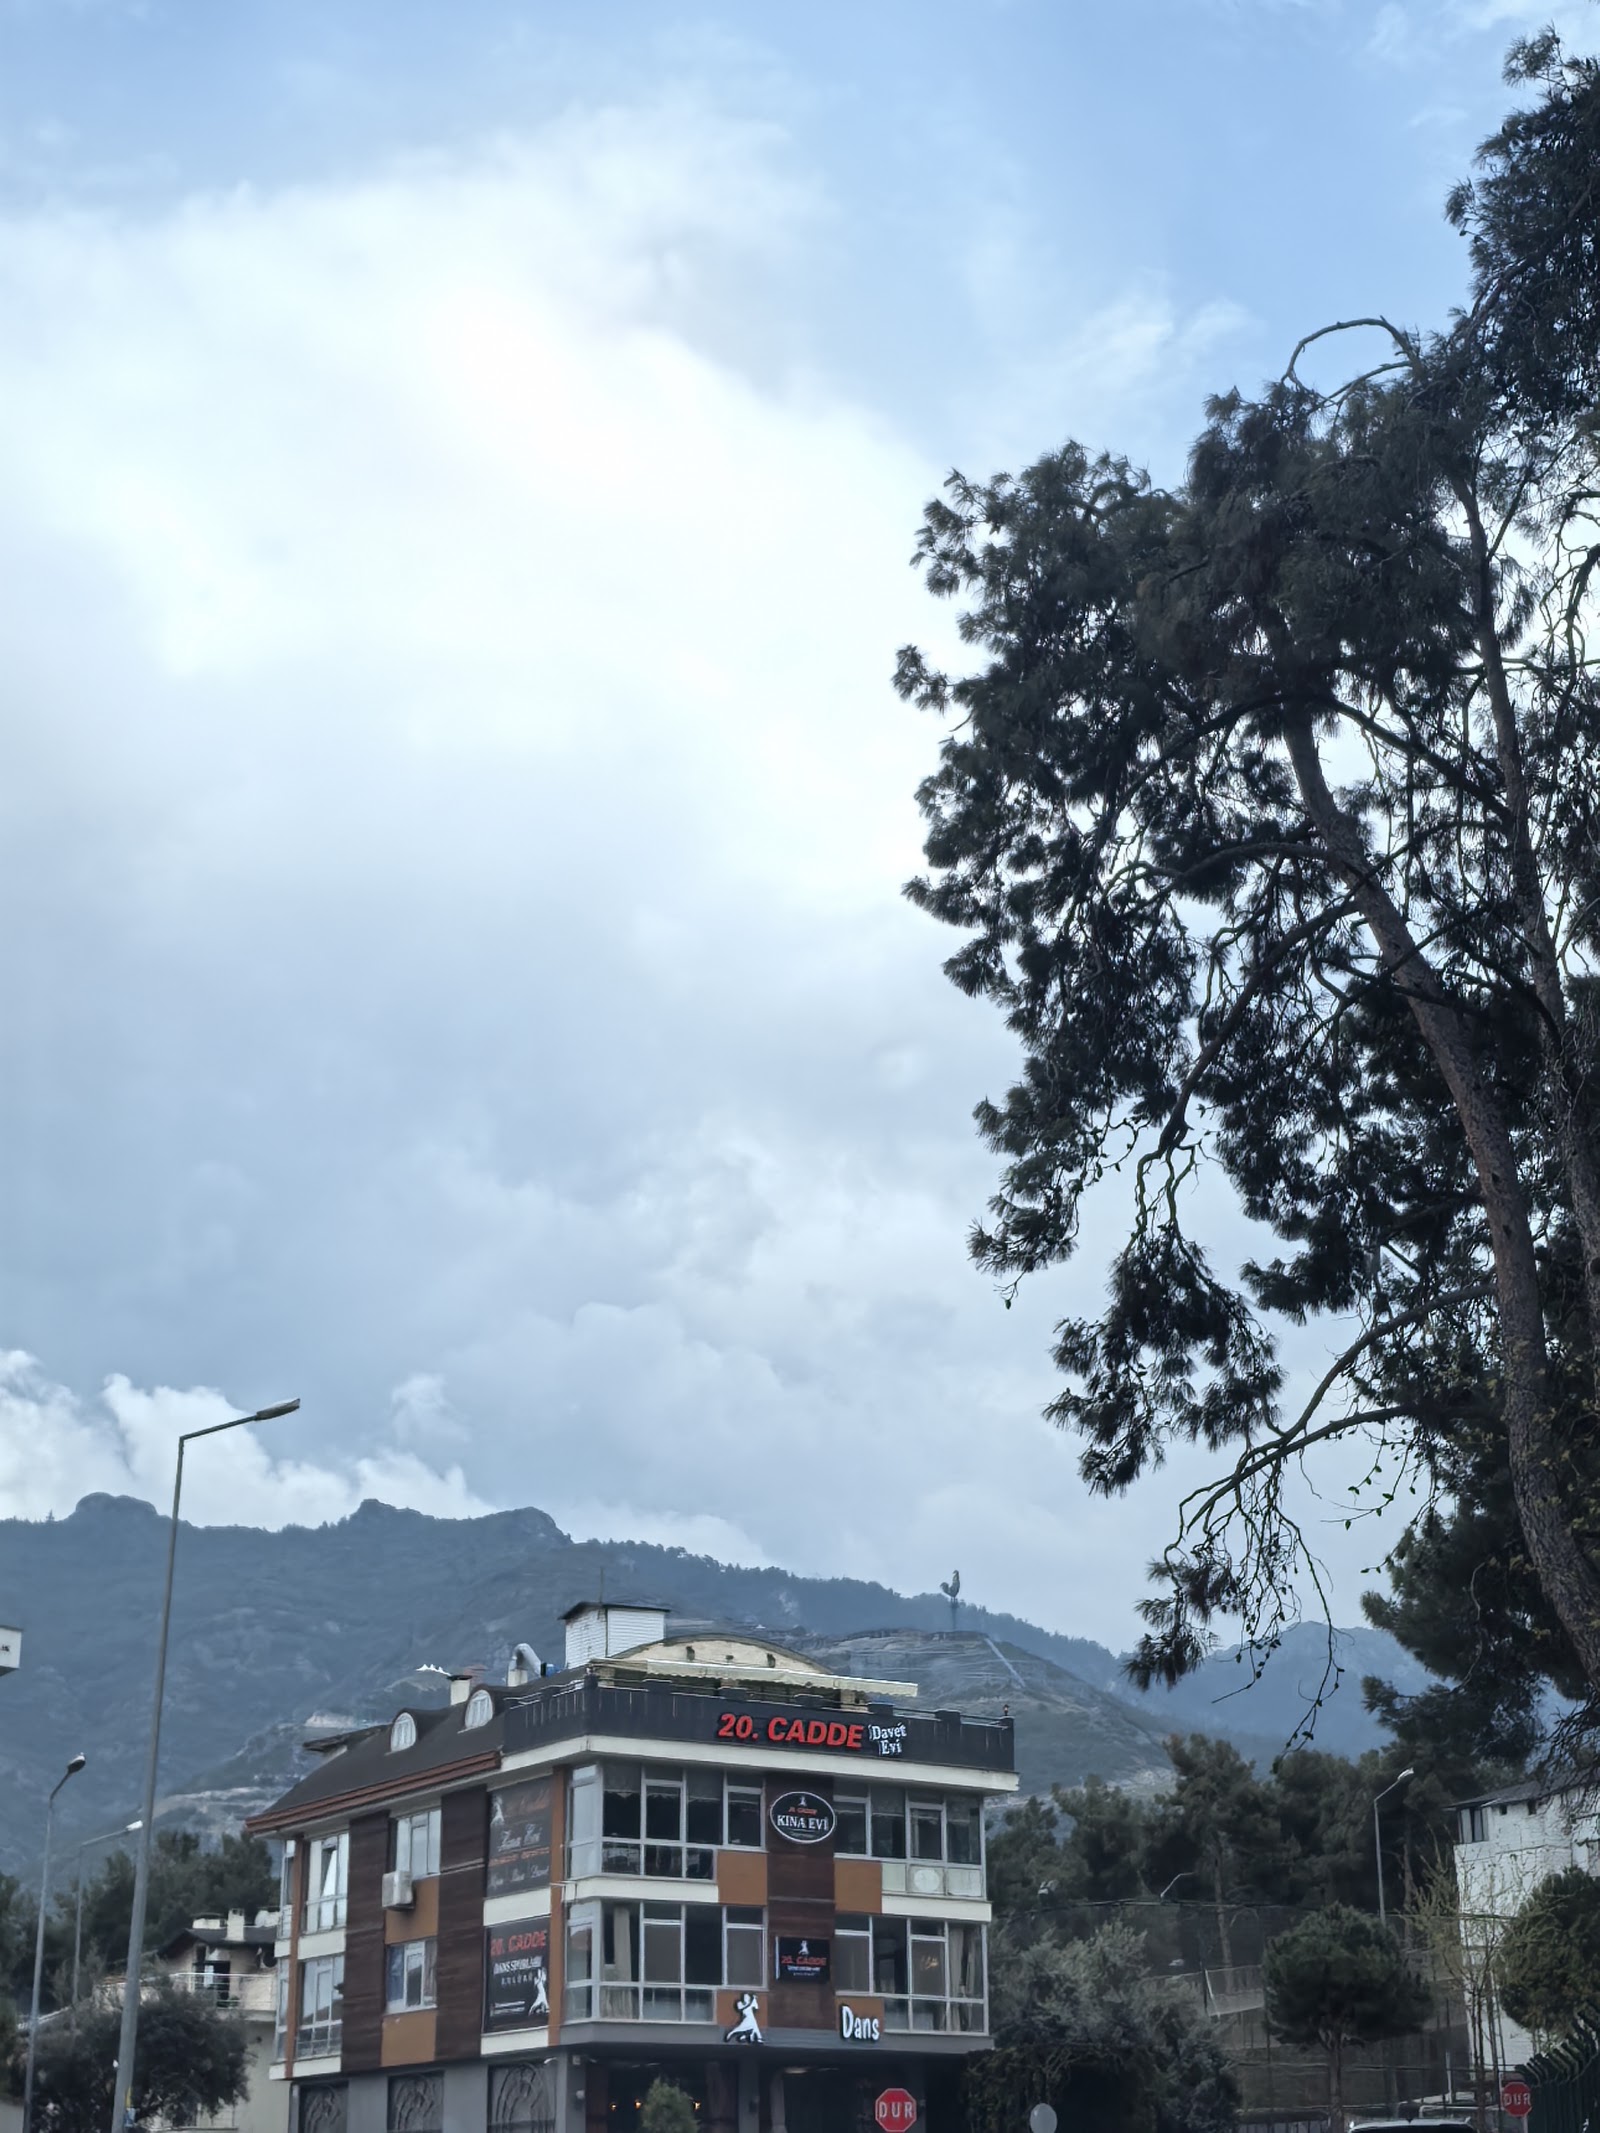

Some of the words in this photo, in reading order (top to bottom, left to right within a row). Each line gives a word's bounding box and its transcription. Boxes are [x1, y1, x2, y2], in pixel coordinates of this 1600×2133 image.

[718, 1713, 759, 1739] 20.
[768, 1716, 864, 1748] CADDE
[777, 1814, 807, 1829] KINA
[507, 1930, 547, 1953] CADDE
[841, 2005, 880, 2041] Dans
[1503, 2092, 1531, 2106] DUR
[879, 2101, 913, 2119] DUR
